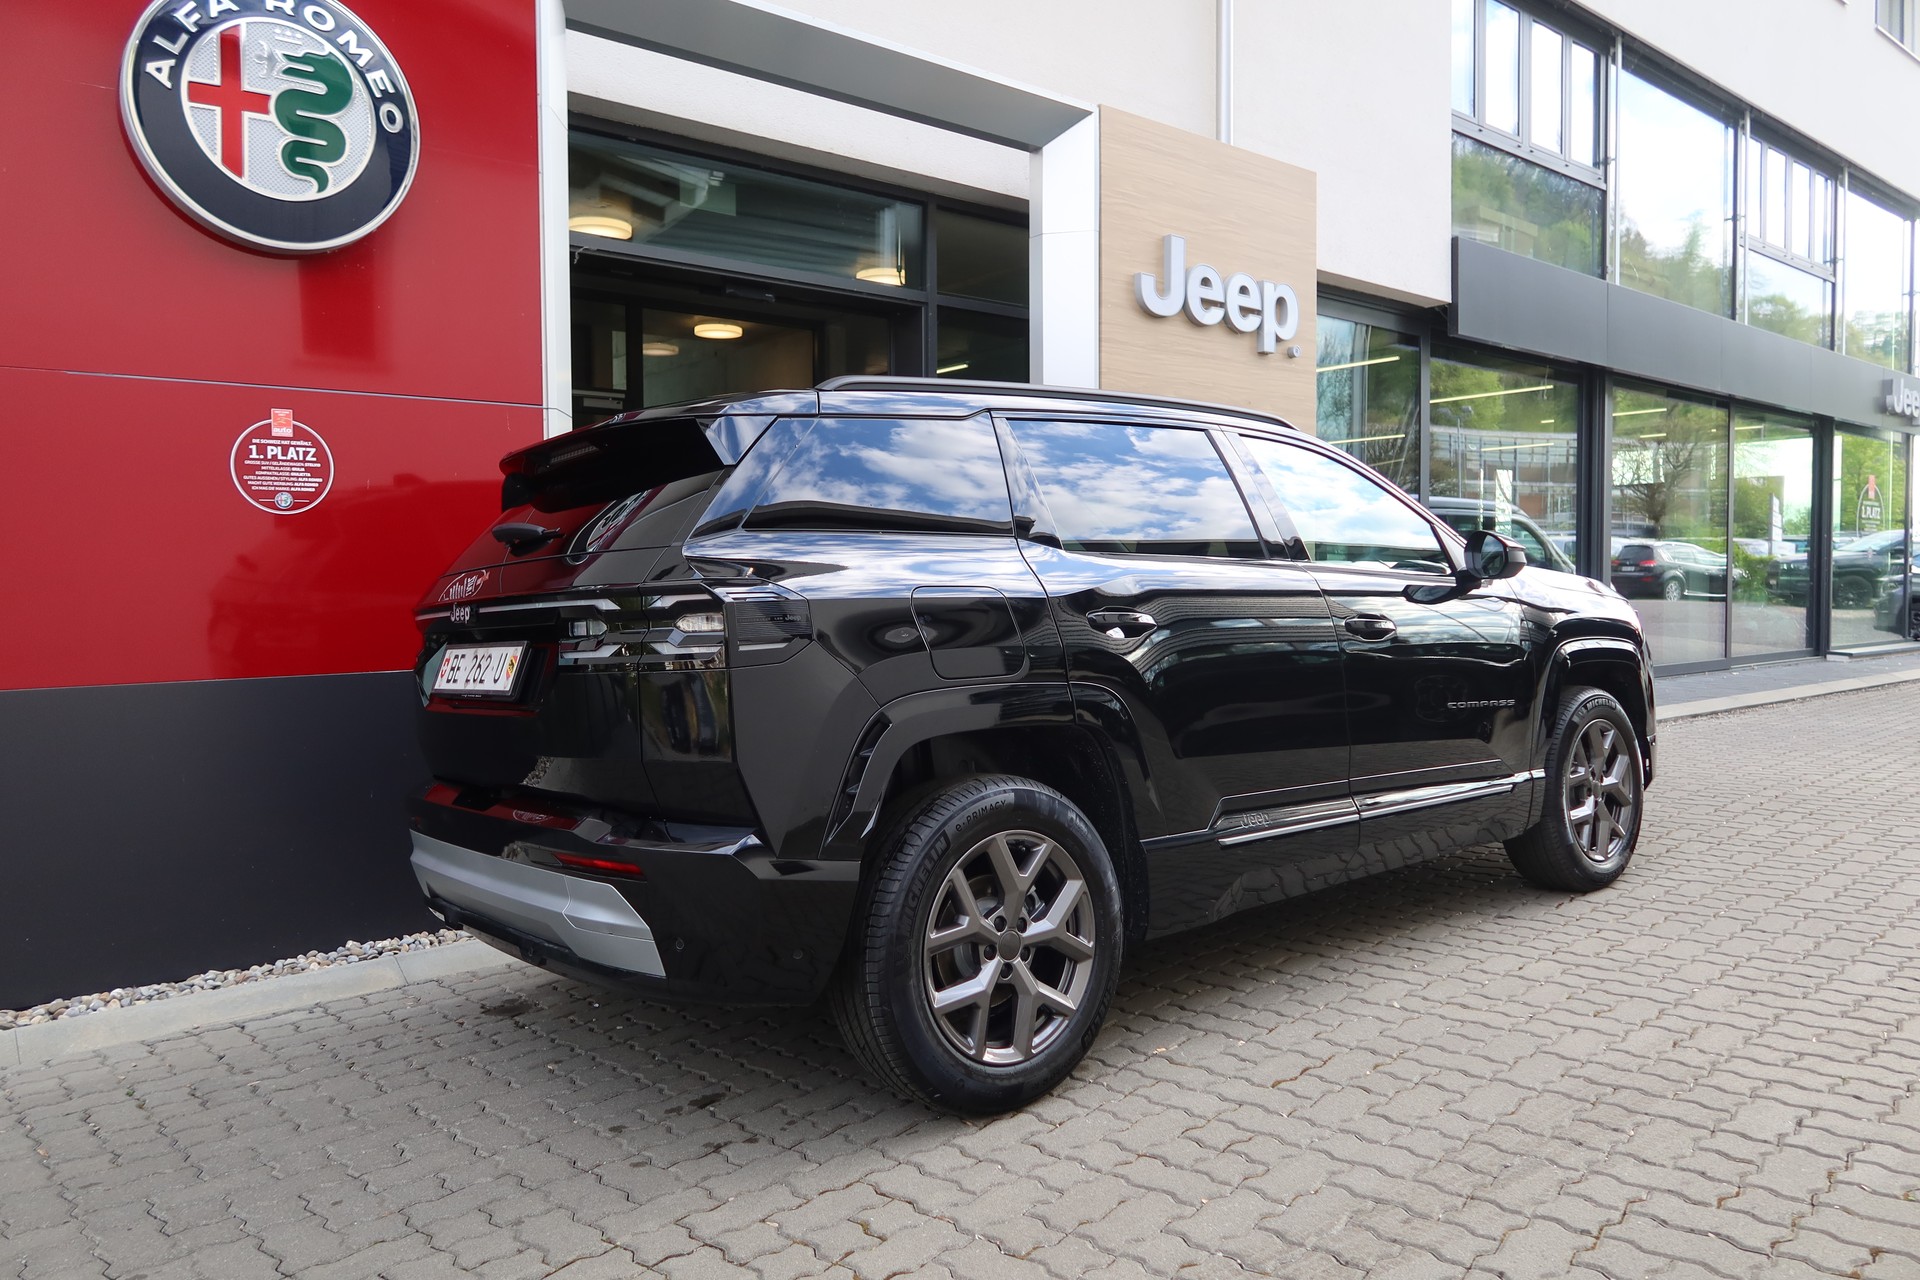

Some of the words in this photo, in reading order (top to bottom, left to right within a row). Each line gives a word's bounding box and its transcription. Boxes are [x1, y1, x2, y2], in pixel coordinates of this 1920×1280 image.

[145, 0, 240, 90] ALFA
[265, 0, 404, 134] ROMEO
[1885, 378, 1920, 426] Jee
[248, 444, 264, 459] 1.
[266, 445, 317, 461] PLATZ
[450, 602, 471, 624] Jeep
[785, 614, 802, 622] Jeep
[445, 653, 466, 684] BE
[465, 654, 493, 684] 262
[493, 652, 509, 684] U
[1447, 699, 1516, 709] COMPASS
[1586, 698, 1616, 711] MICHELIN
[1240, 812, 1270, 829] Jeep
